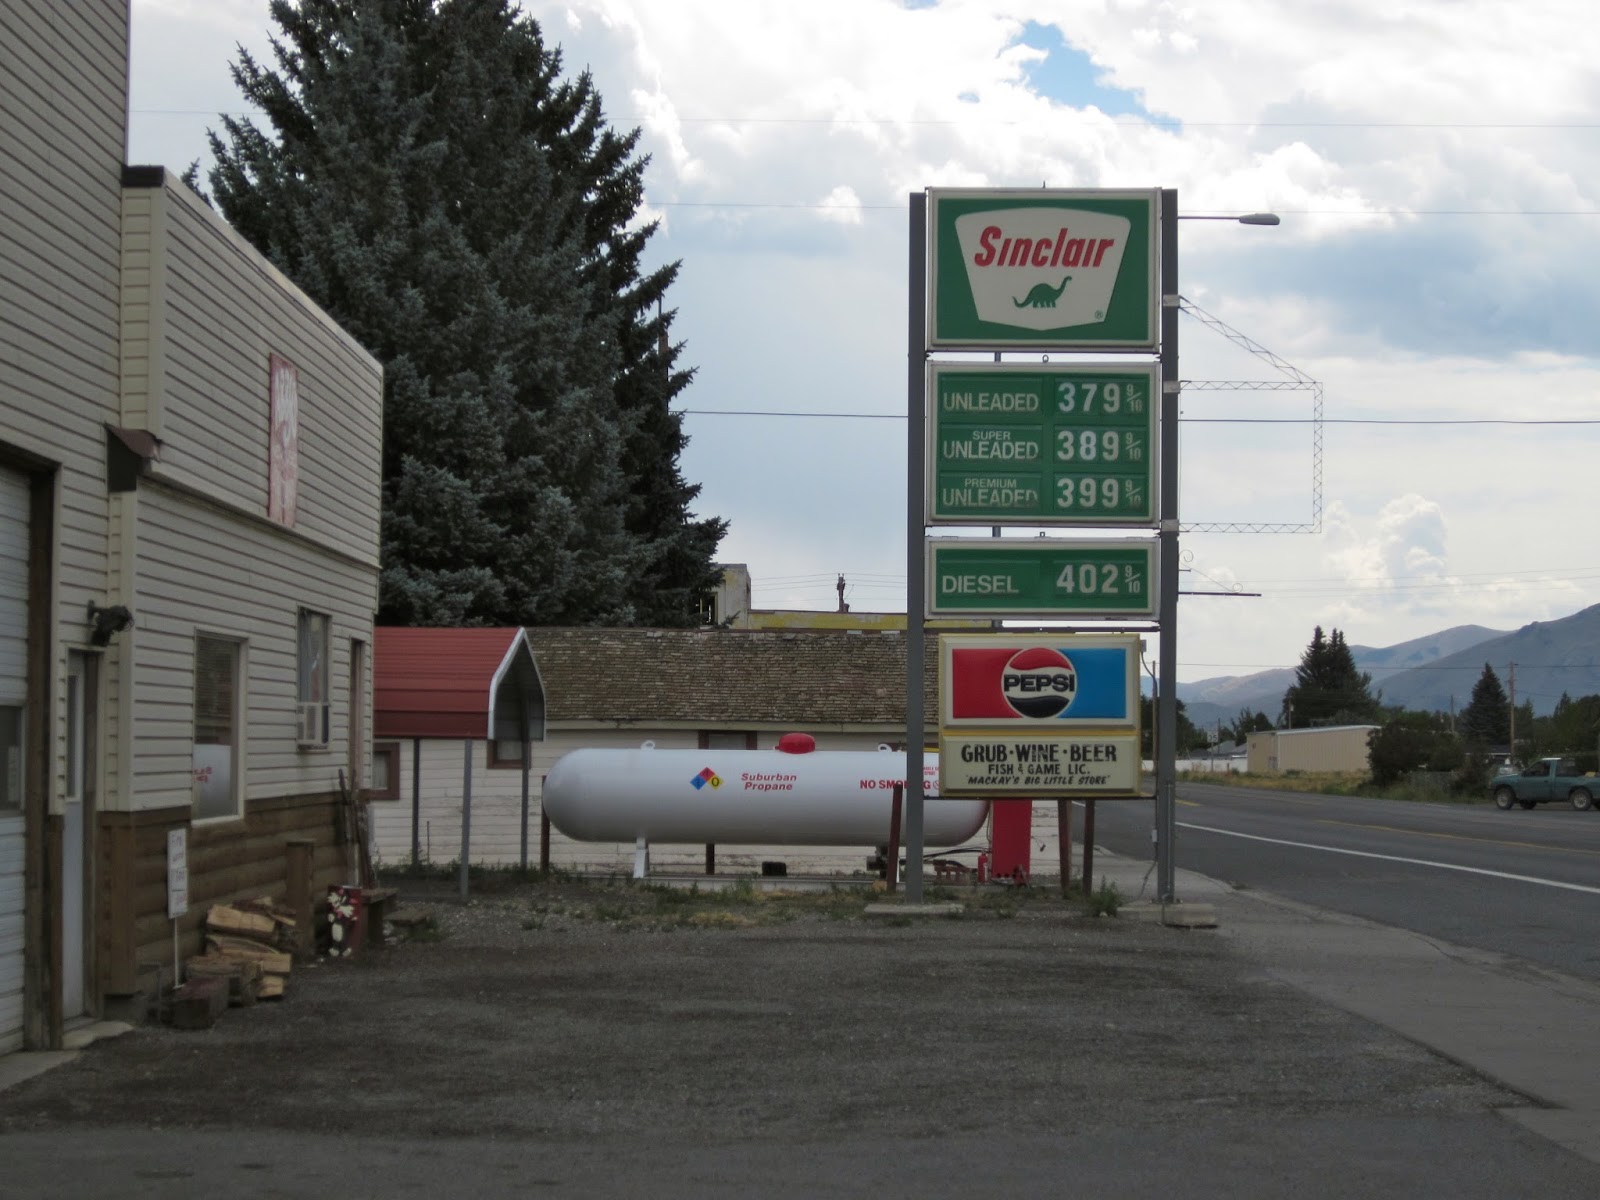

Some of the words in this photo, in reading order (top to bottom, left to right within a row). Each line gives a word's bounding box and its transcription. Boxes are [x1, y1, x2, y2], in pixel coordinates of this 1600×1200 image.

[974, 225, 1115, 268] Sinclair
[943, 393, 1039, 412] UNLEADED
[1058, 382, 1120, 413] 379
[972, 431, 1011, 441] SUPER
[943, 442, 1039, 460] UNLEADED
[1057, 430, 1120, 461] 389
[964, 478, 1017, 488] PREMIUM
[942, 490, 1039, 508] UNLEADED
[1057, 478, 1119, 508] 399
[942, 575, 1020, 593] DIESEL
[1056, 564, 1119, 593] 402
[1003, 674, 1075, 692] PEPSI
[988, 764, 1014, 775] FISH
[1028, 764, 1060, 775] GAME
[1068, 764, 1090, 775] LIC.
[741, 773, 797, 782] Suburban
[1025, 776, 1041, 785] BIG
[1044, 776, 1073, 785] LITTLE
[744, 781, 793, 791] Propane
[860, 780, 876, 790] NO
